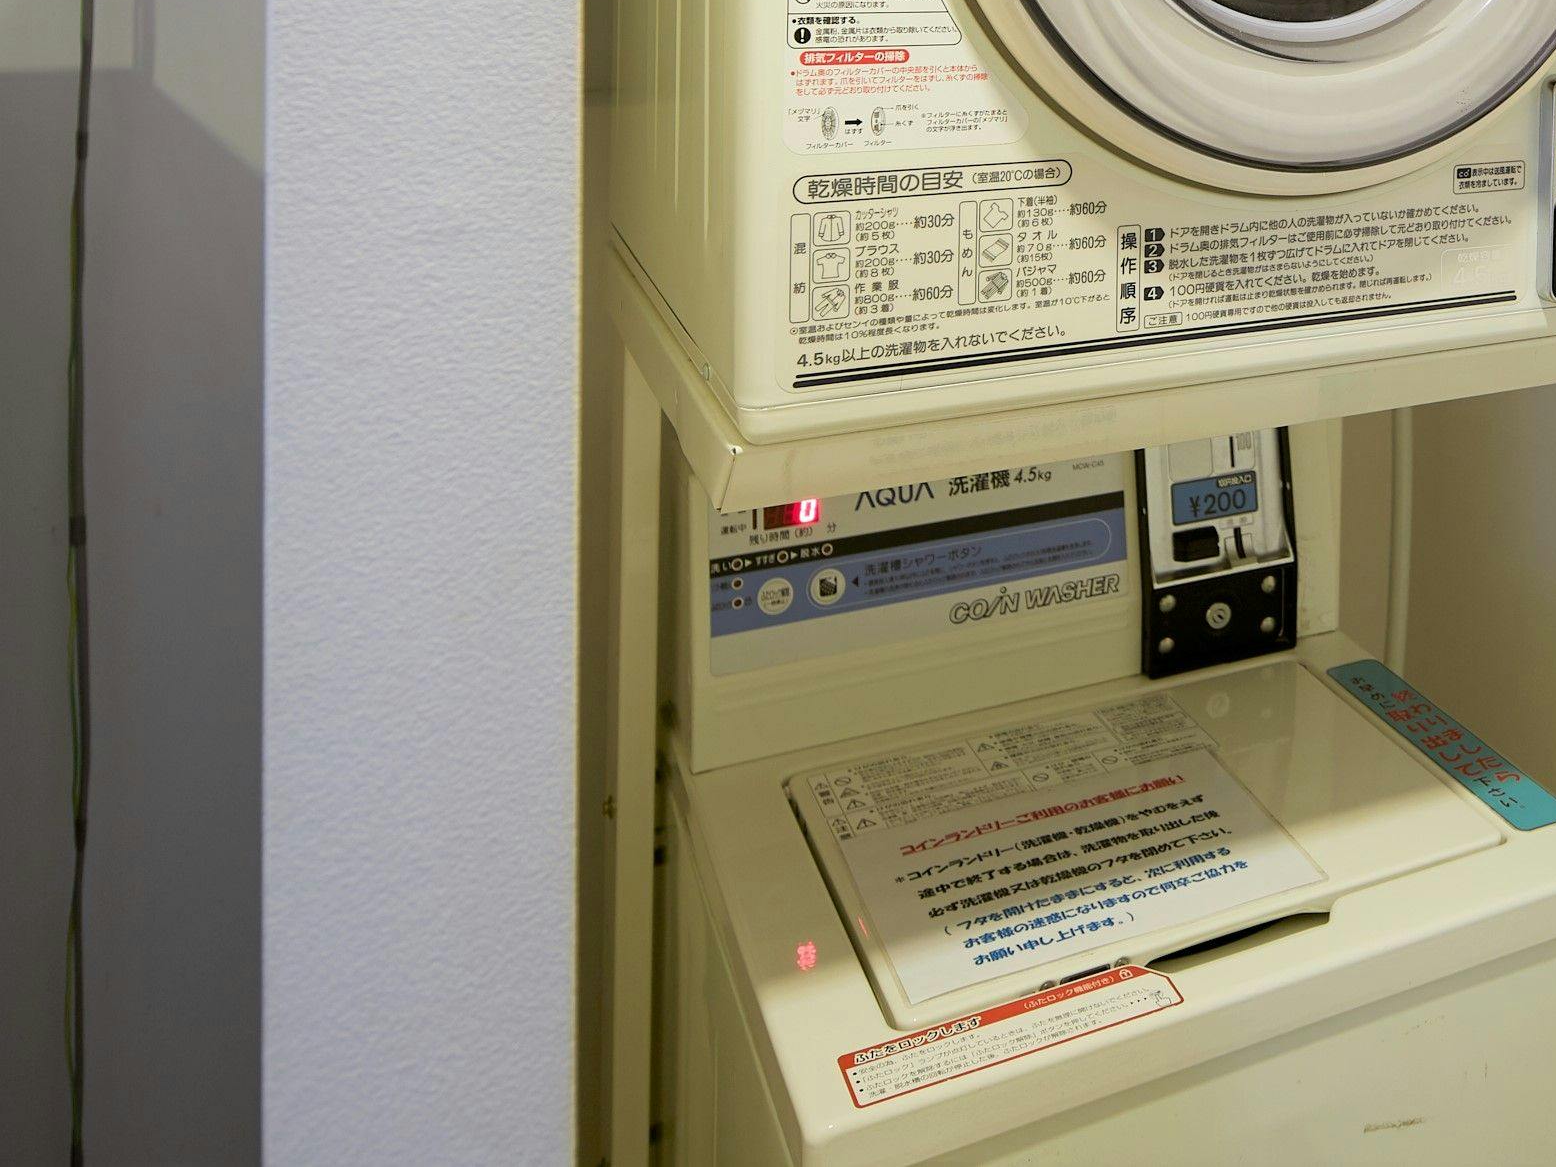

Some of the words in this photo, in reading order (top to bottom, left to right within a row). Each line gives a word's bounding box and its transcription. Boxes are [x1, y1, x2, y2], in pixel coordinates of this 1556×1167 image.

[816, 1, 890, 9] 火災の原因になります。
[797, 17, 860, 25] 衣類を確認する。
[804, 50, 905, 64] 排気フィルターの掃除
[807, 170, 964, 199] 乾燥時間の目安
[1459, 178, 1517, 189] 衣類を冷ましています。
[855, 207, 899, 220] カッターシャツ
[1149, 229, 1157, 241] 1
[1170, 203, 1479, 238] ドアを開きドラム内に他の人の洗濯物が入っていないか確かめてください。
[855, 244, 899, 257] ブラウス
[1149, 245, 1158, 257] 2
[1148, 261, 1157, 272] 3
[1148, 288, 1158, 300] 4
[1170, 266, 1382, 297] 100円硬貨を入れてください。乾燥を始めます。
[1148, 315, 1177, 325] ご注意
[796, 326, 1067, 367] 4.5kg以上の洗濯物を入れないでください。
[800, 498, 817, 522] 0
[1189, 489, 1246, 517] ¥200
[1025, 574, 1120, 609] WASHER
[918, 811, 1220, 899] 途中で終了する場合は、洗濯物を取り出した後
[963, 860, 1249, 949] お客様の迷惑になりますので何卒ご協力を
[856, 1017, 980, 1063] ふたをロックします
